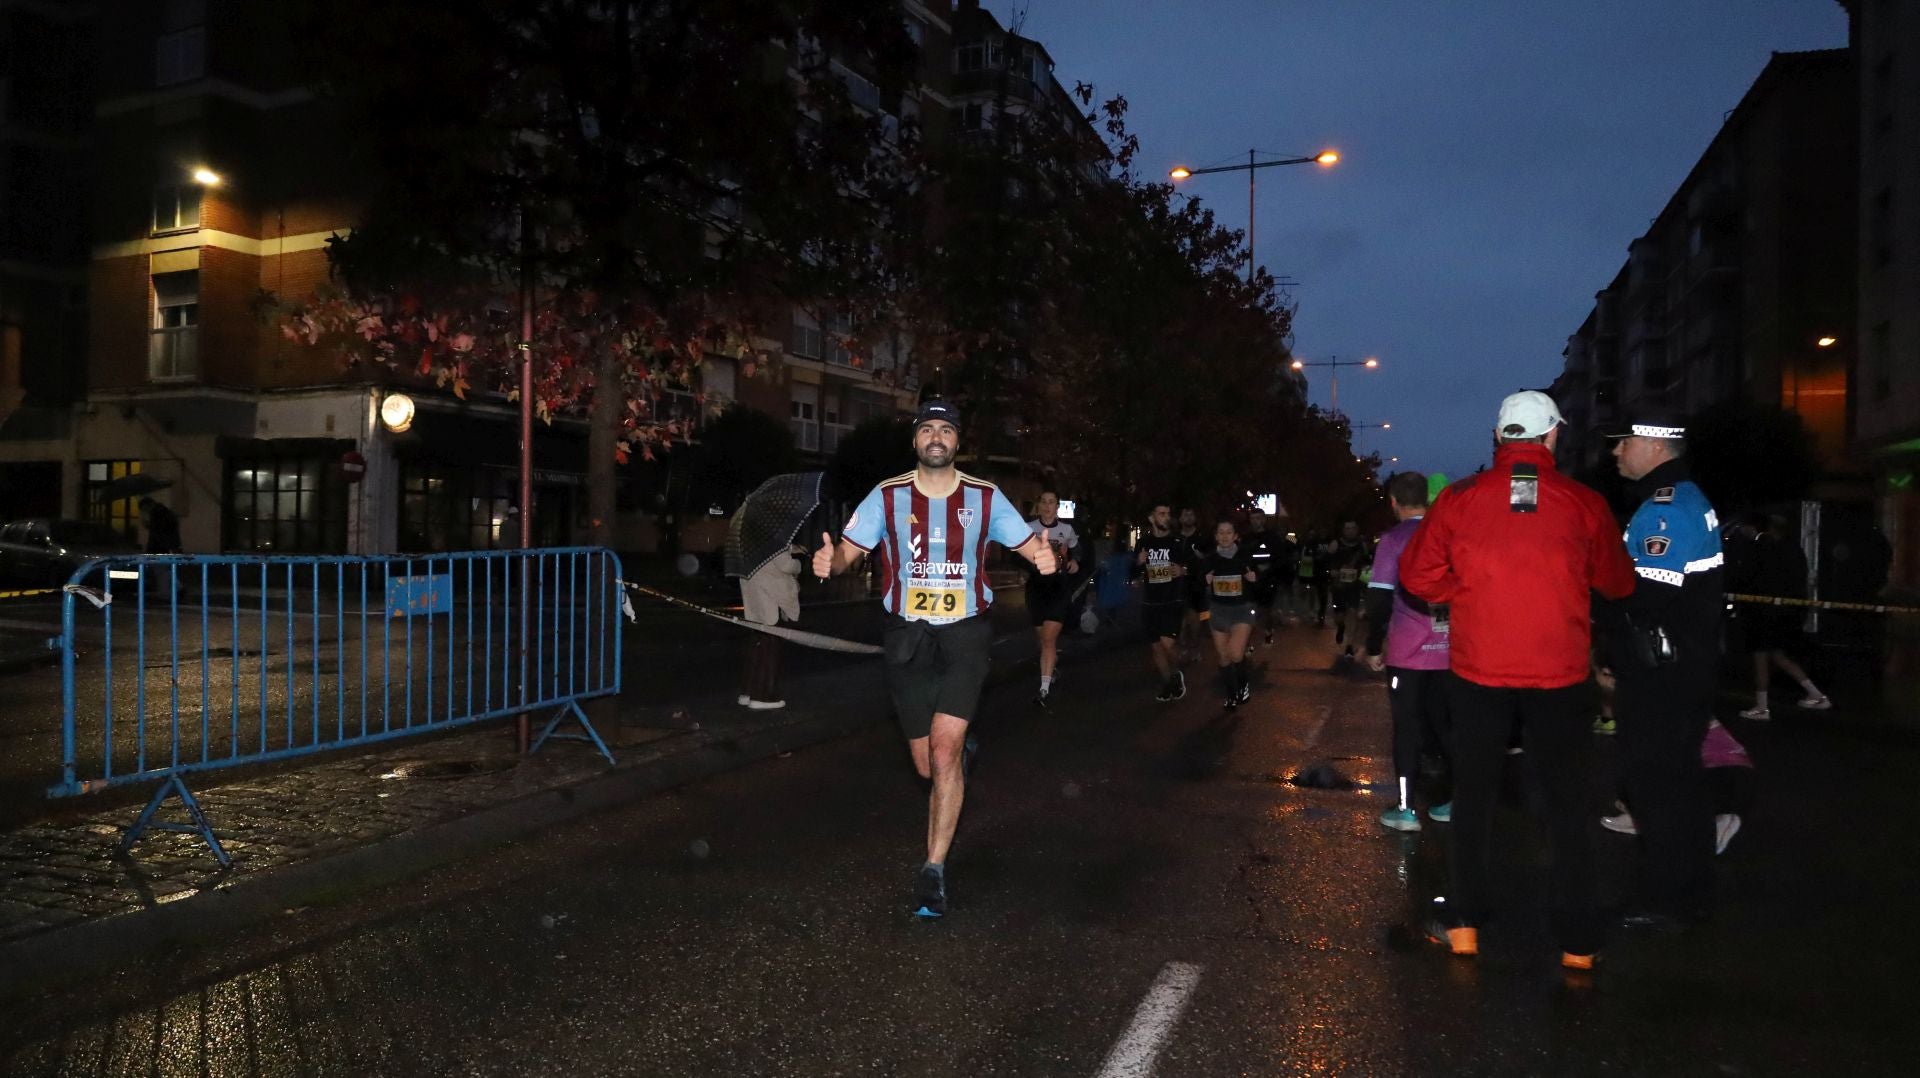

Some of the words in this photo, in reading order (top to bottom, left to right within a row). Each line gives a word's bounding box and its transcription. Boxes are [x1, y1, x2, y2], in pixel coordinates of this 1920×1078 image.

[1148, 548, 1170, 560] 3x7K
[905, 558, 969, 577] cajaviva
[914, 592, 956, 612] 279
